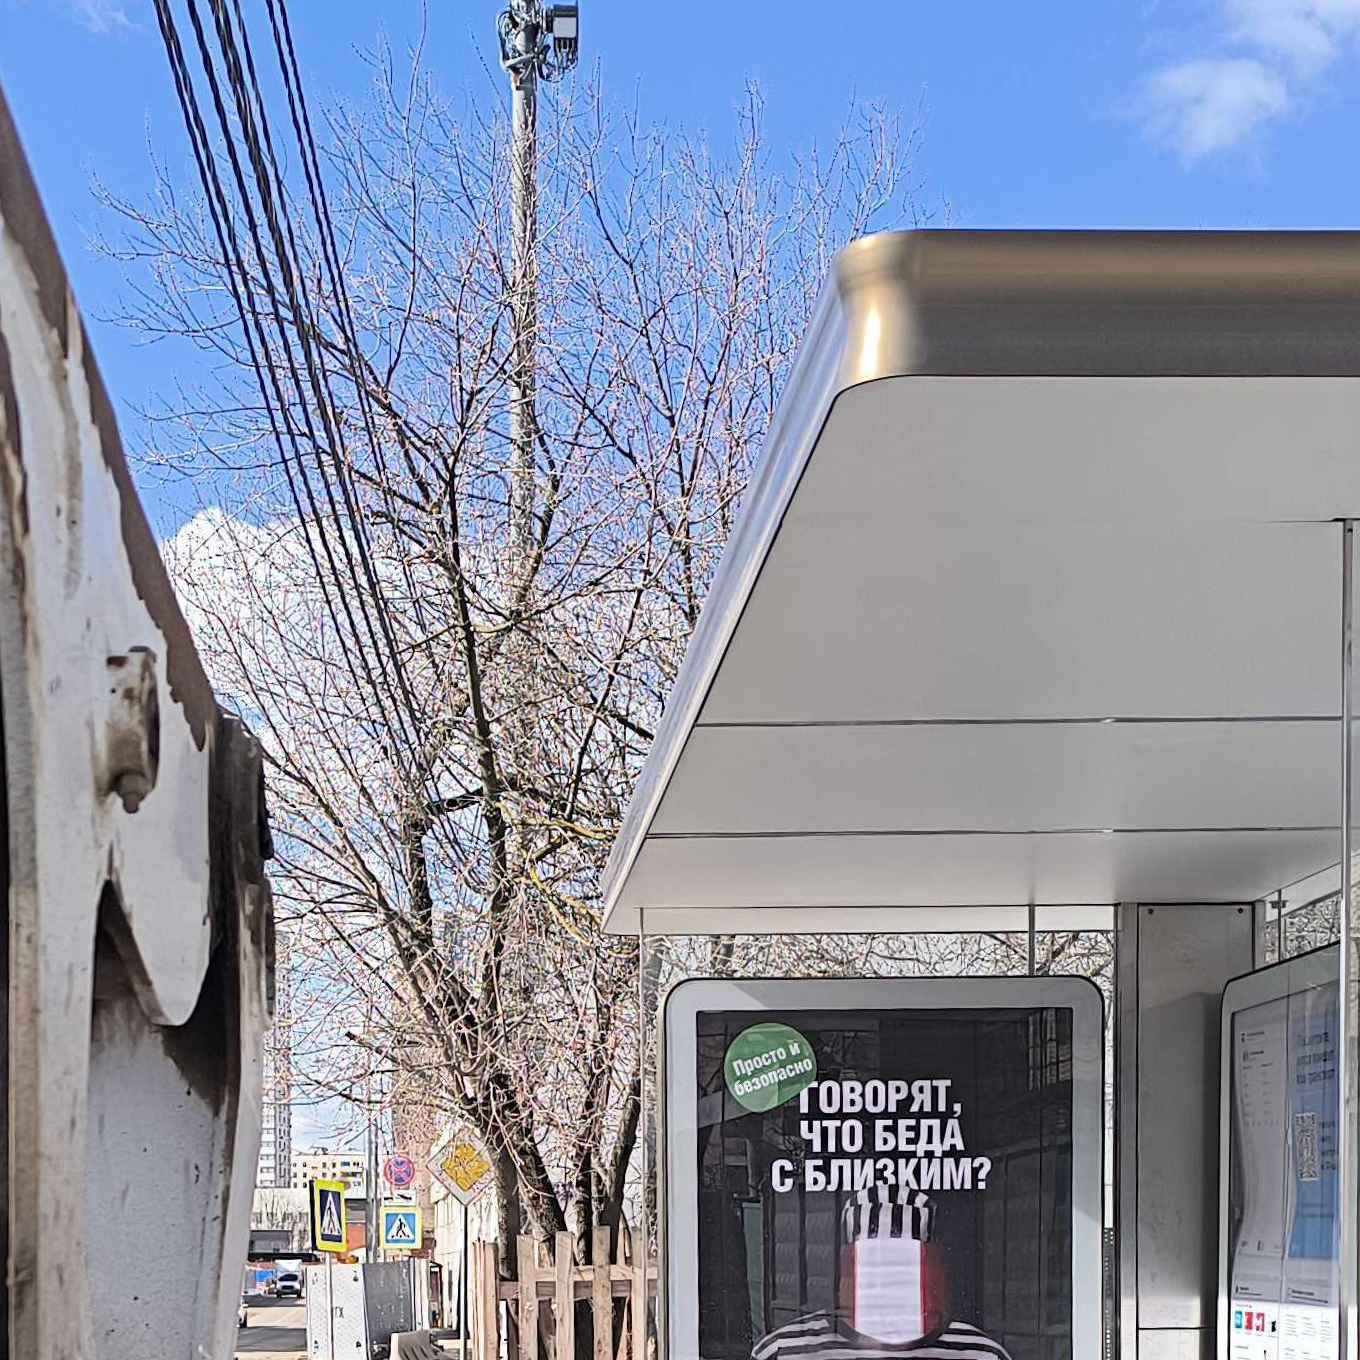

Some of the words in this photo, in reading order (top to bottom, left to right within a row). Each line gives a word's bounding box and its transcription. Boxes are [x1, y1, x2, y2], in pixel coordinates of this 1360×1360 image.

[732, 1047, 787, 1077] Просто
[734, 1057, 814, 1097] безопасно
[799, 1079, 962, 1117] ГОВОРЯТ,
[800, 1119, 863, 1153] ЧТО
[874, 1118, 965, 1157] БЕДА
[771, 1159, 794, 1193] С
[805, 1156, 992, 1192] БЛИЗКИМ?
